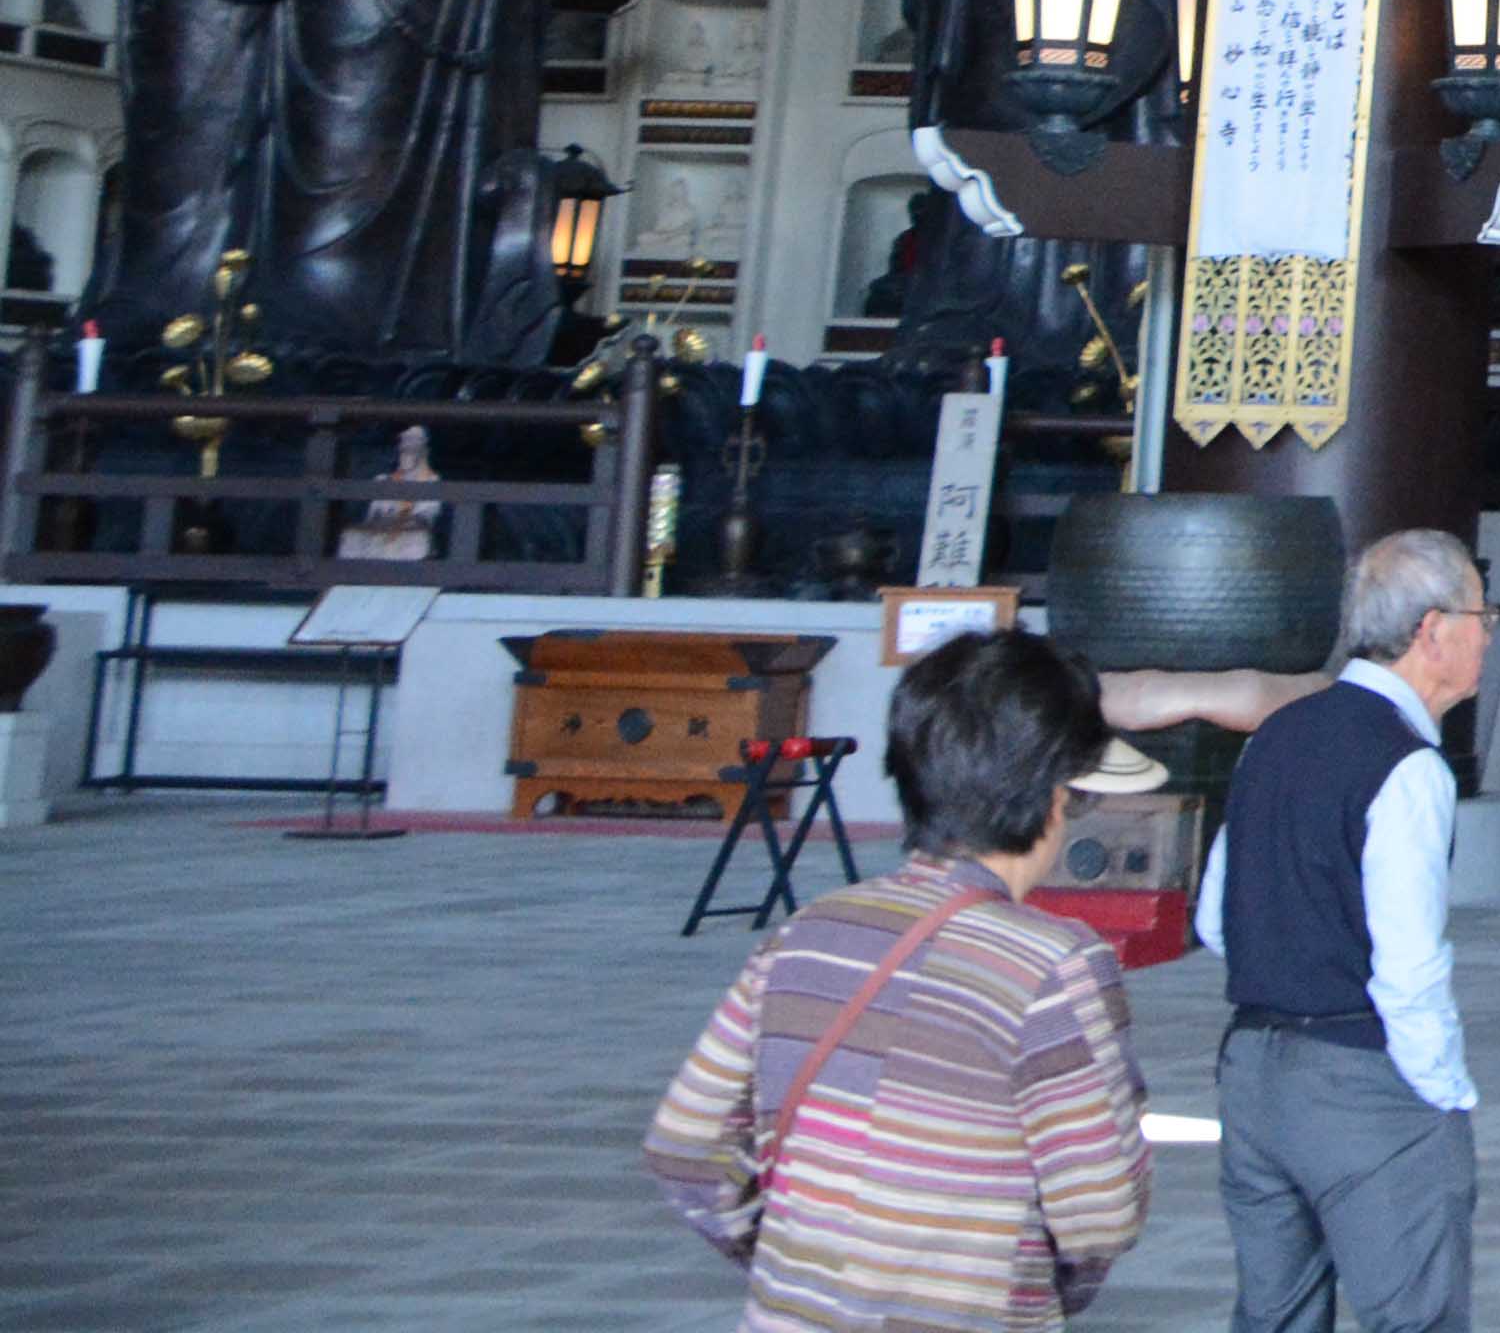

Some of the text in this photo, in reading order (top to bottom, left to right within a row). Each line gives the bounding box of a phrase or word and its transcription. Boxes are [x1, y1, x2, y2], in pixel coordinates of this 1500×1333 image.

[1218, 44, 1245, 148] 妙心寺
[922, 483, 981, 588] 阿難
